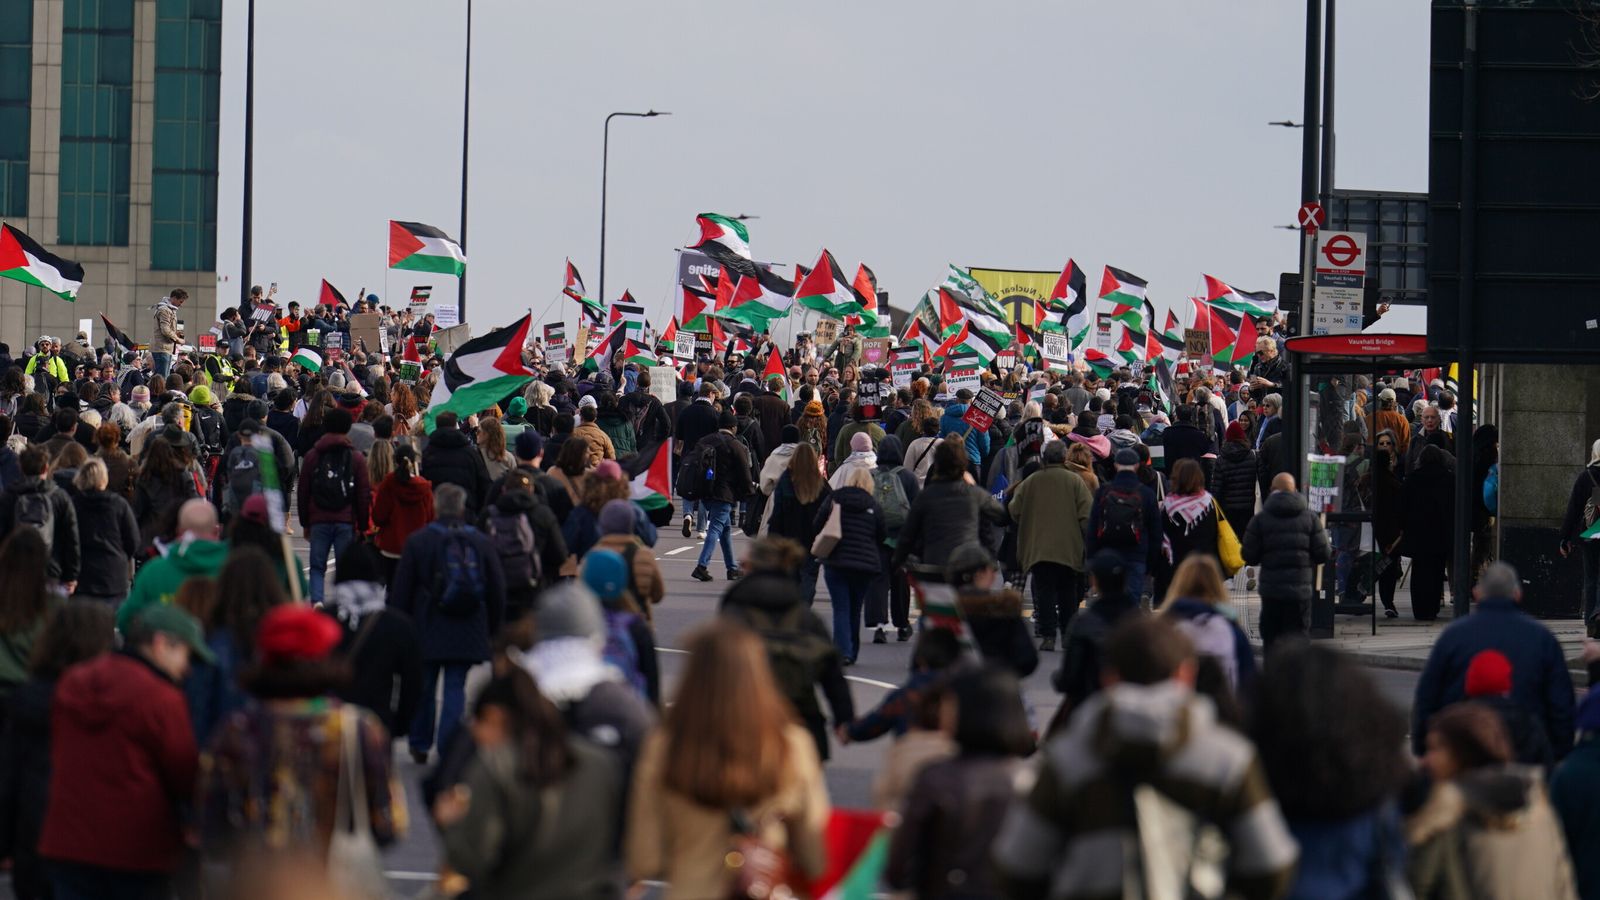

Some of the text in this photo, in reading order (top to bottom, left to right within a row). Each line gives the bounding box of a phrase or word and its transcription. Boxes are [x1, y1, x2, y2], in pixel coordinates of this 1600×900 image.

[1302, 207, 1320, 226] X
[198, 335, 216, 347] FREE
[1044, 335, 1066, 345] CEASEFIRE
[1375, 338, 1395, 346] Bridge
[696, 341, 712, 349] OCIDE
[893, 369, 914, 377] PALEST
[947, 376, 980, 384] PALESTINE
